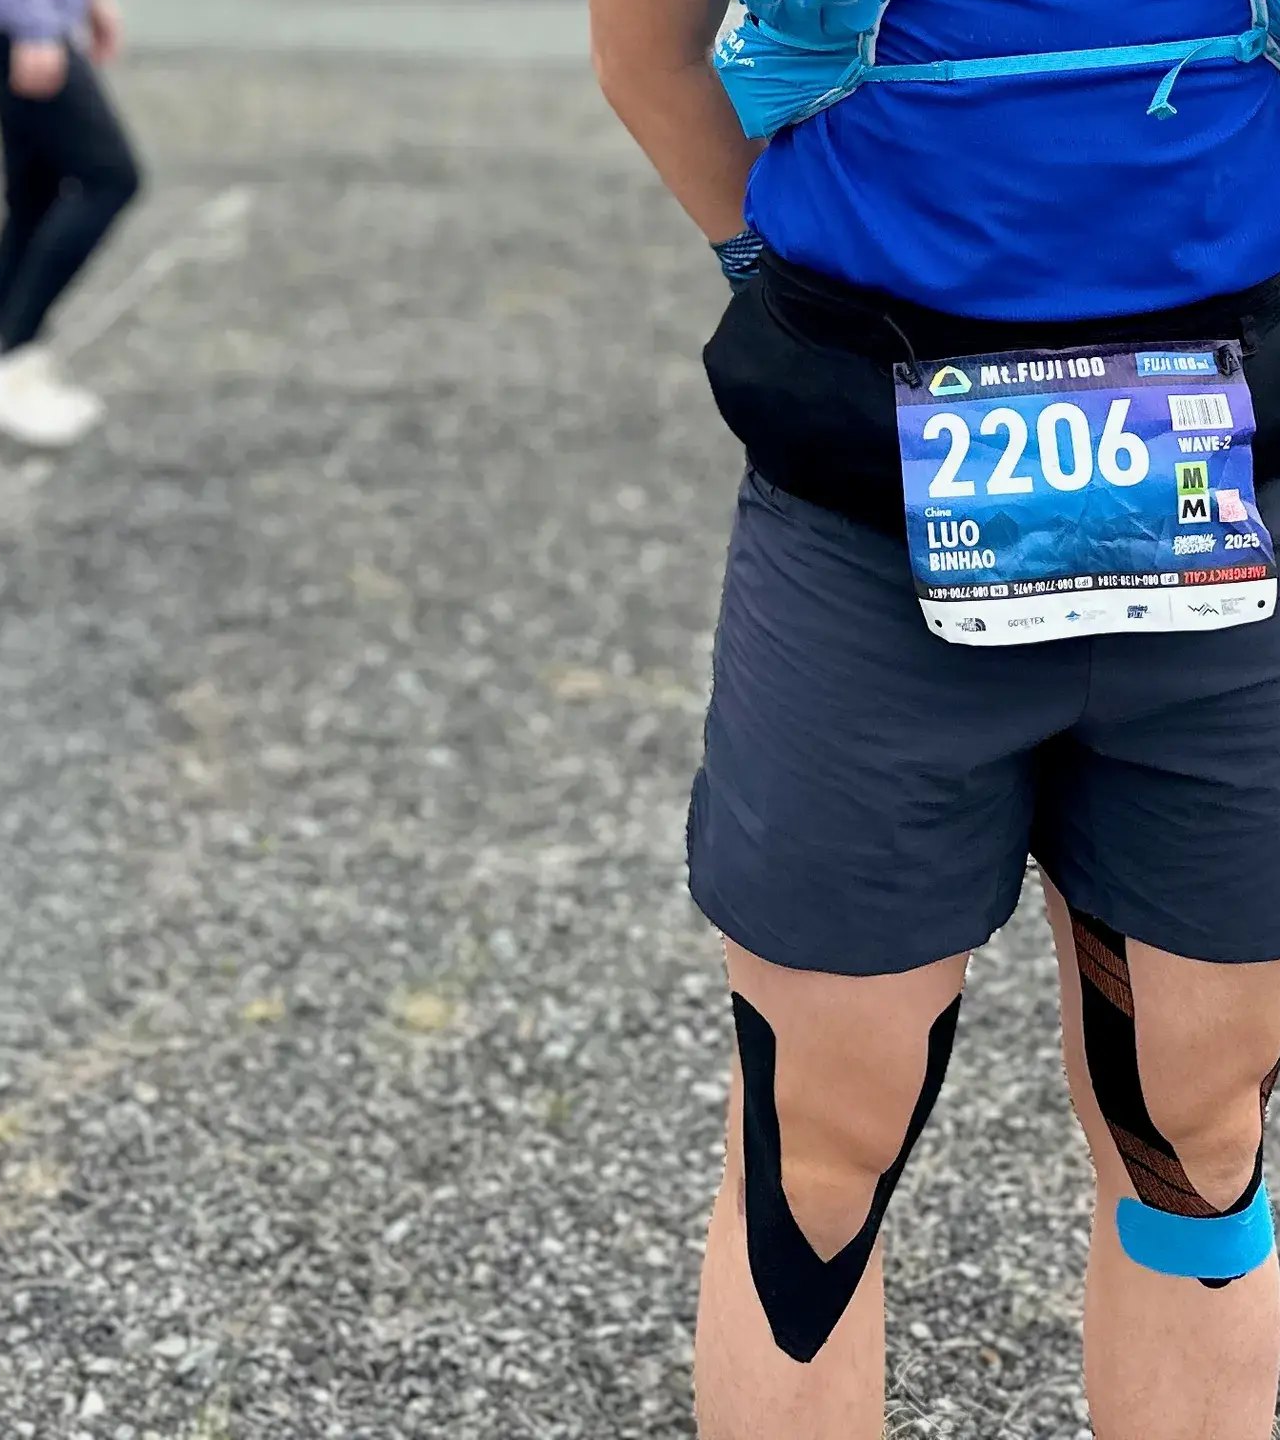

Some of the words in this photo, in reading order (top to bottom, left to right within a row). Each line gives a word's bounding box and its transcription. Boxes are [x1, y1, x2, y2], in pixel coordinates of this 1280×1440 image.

[980, 359, 1063, 387] Mt.FUJI
[1068, 356, 1106, 379] 100
[1143, 357, 1172, 372] FUJI
[922, 398, 1151, 499] 2206
[1178, 435, 1232, 453] WAVE-2
[1183, 467, 1204, 489] M
[924, 506, 952, 518] China
[1182, 498, 1207, 519] M
[927, 519, 980, 549] LUO
[1224, 533, 1261, 550] 2025
[929, 549, 996, 572] BINHAO
[1184, 569, 1207, 584] CALL
[1209, 565, 1267, 582] EMERGENCY
